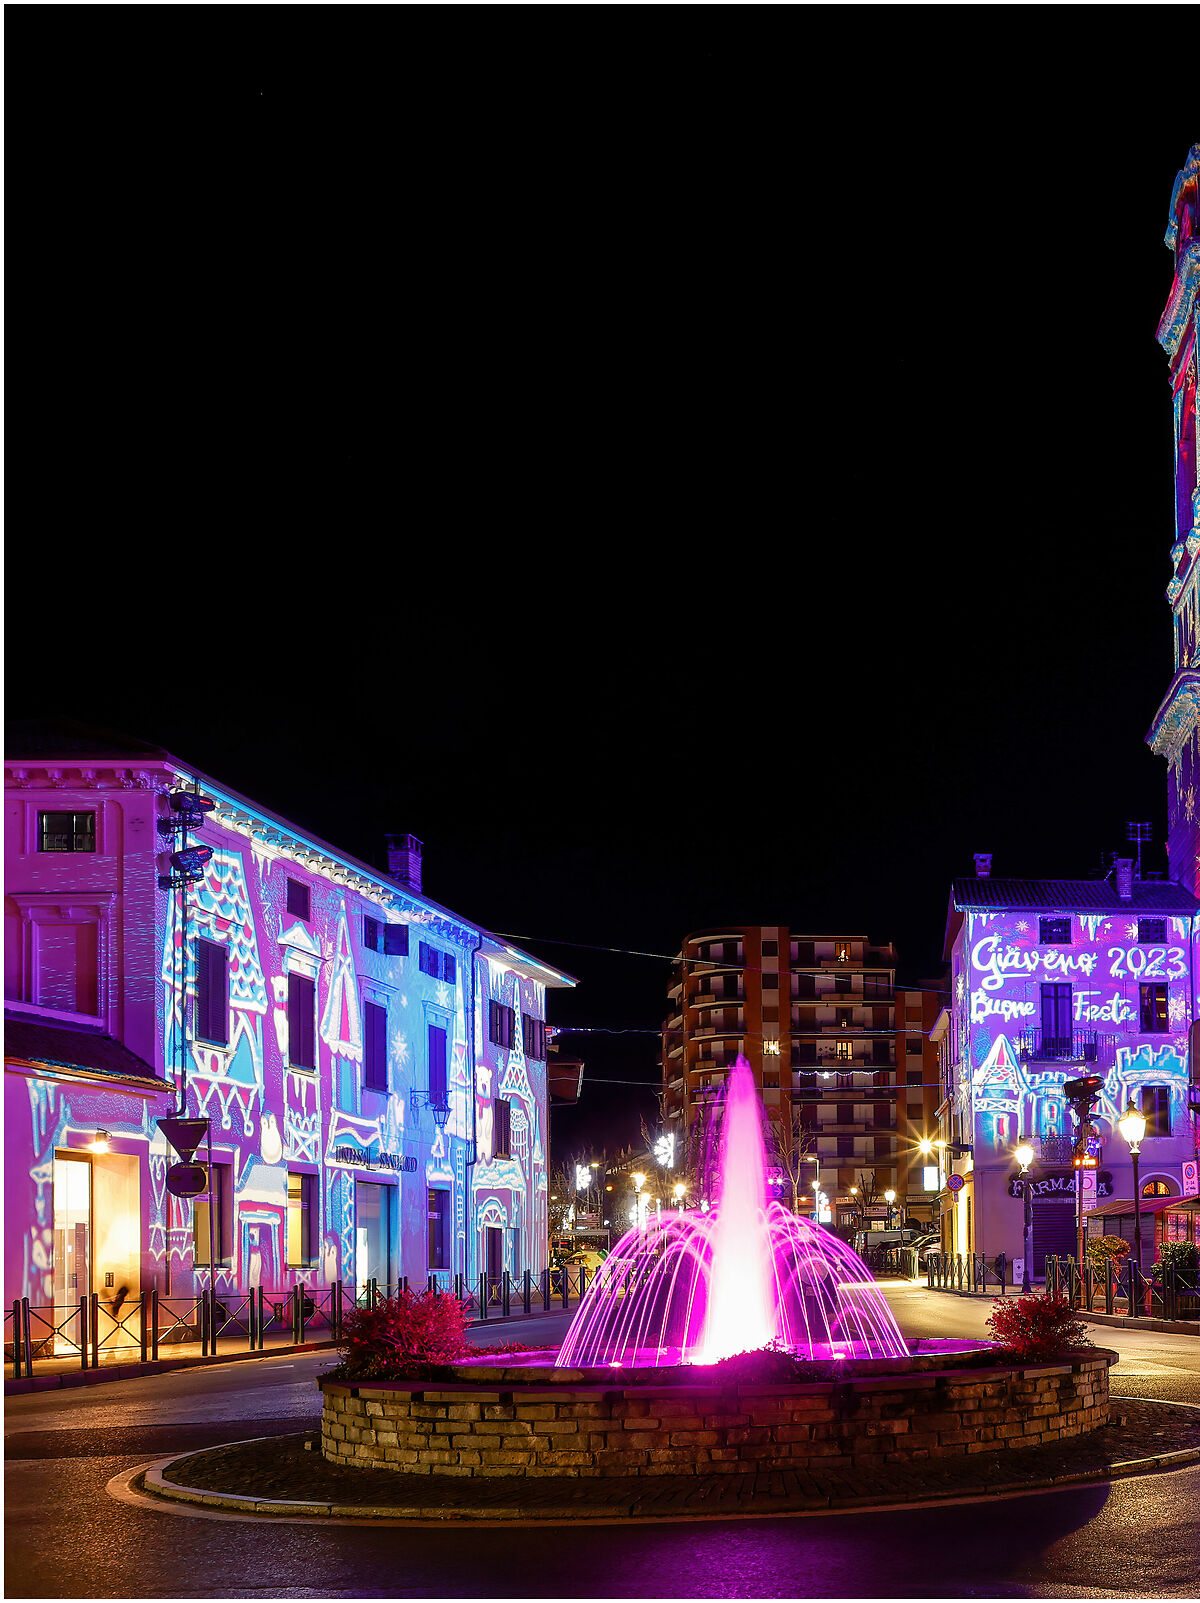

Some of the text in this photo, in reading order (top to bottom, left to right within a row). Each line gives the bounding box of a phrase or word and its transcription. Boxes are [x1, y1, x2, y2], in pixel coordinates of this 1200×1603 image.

[971, 934, 1189, 991] Giaveno 2023
[970, 987, 1138, 1024] Buone Feste
[1012, 1177, 1109, 1197] FRMAA
